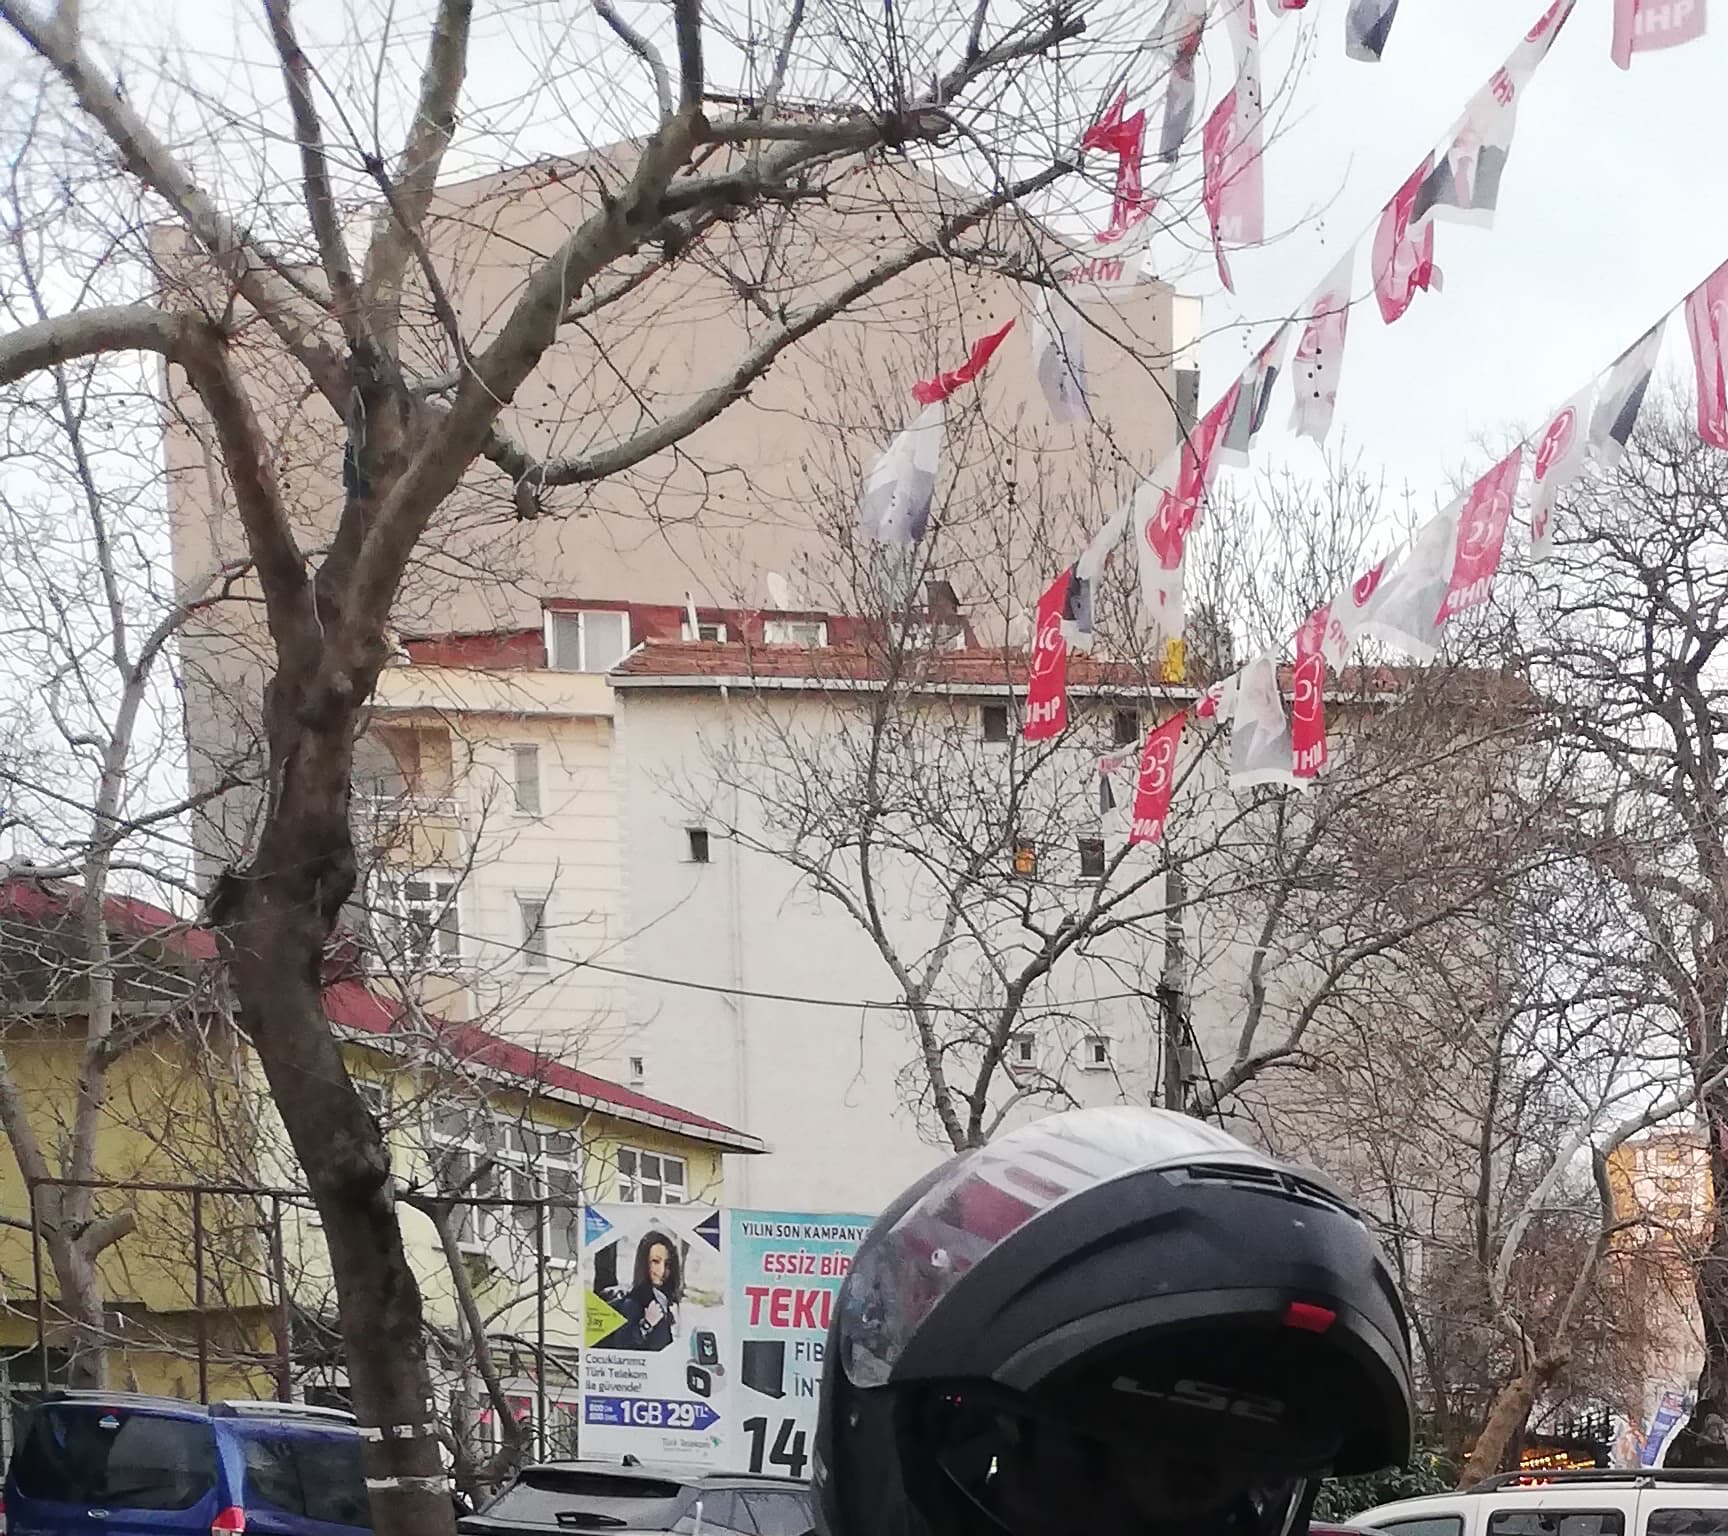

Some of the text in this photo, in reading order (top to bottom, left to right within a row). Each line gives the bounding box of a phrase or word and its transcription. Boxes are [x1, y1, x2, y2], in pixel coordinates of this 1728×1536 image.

[741, 1222, 774, 1237] YILIN
[775, 1224, 801, 1239] SON
[764, 1249, 815, 1280] EŞSİZ
[585, 1366, 648, 1381] Türk Telekom
[620, 1400, 663, 1425] 1GB
